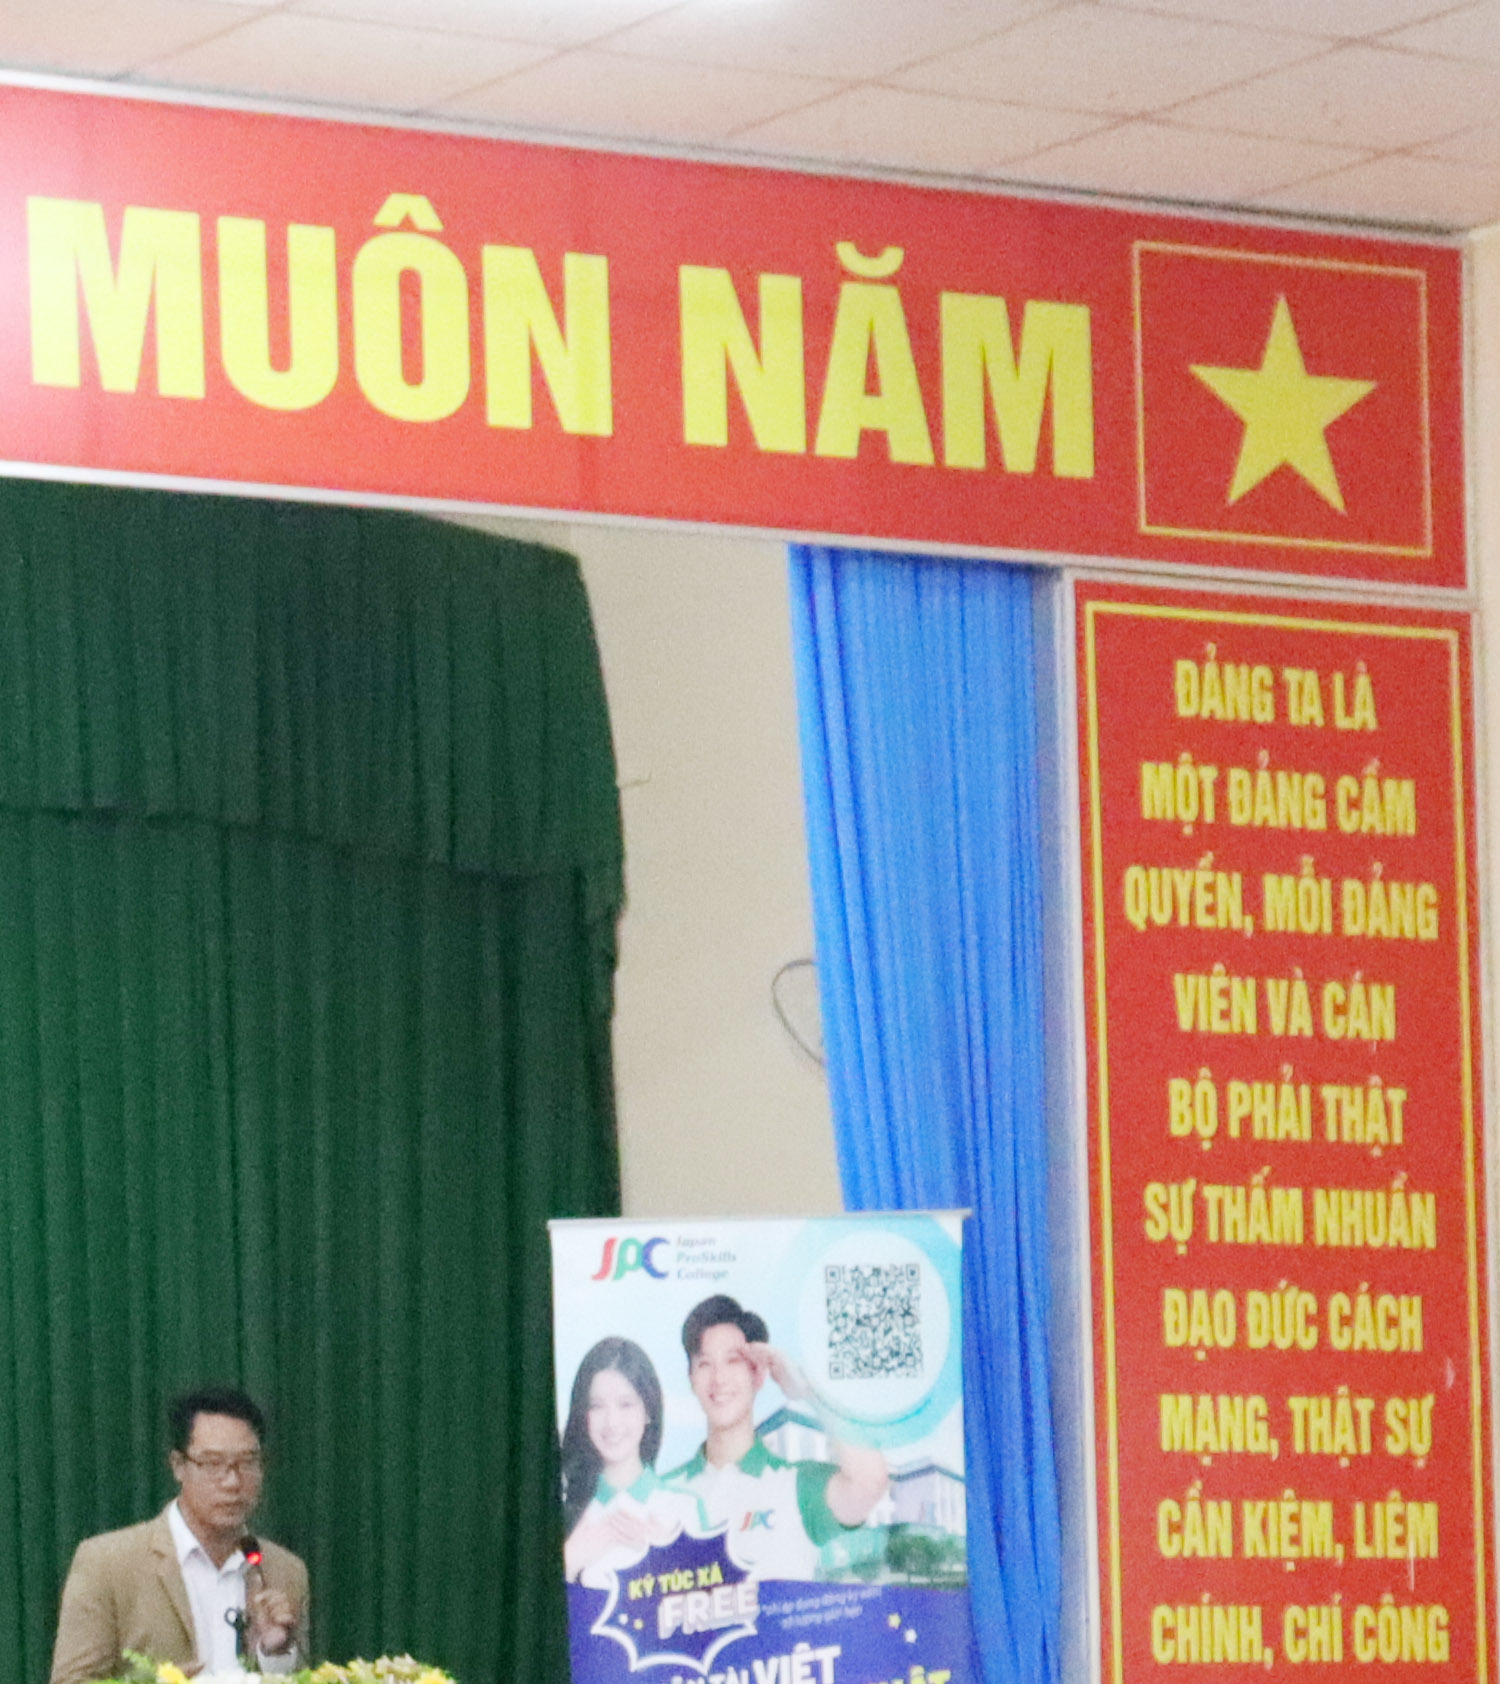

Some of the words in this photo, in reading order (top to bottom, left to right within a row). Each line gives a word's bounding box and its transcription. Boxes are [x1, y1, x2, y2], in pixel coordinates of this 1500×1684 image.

[31, 191, 614, 437] MUÔN
[678, 241, 1095, 478] NĂM
[1174, 642, 1275, 724] ĐẢNG
[1283, 667, 1324, 727] TA
[1333, 661, 1377, 731] LÀ
[1141, 752, 1218, 836] MỘT
[1228, 750, 1327, 831] ĐẢNG
[1263, 855, 1333, 935] MỖI
[1342, 861, 1439, 940] ĐẢNG
[1173, 962, 1257, 1034] VIÊN
[1265, 966, 1313, 1037] VÀ
[1323, 970, 1396, 1041] CÁN
[1168, 1066, 1218, 1151] BỘ
[1227, 1063, 1312, 1141] PHẢI
[1321, 1075, 1407, 1157] THẬT
[1144, 1178, 1197, 1255] SỰ
[1203, 1165, 1304, 1244] THẤM
[592, 1236, 671, 1281] JPC
[1163, 1287, 1237, 1361] ĐẠO
[1246, 1279, 1318, 1350] ĐỨC
[1329, 1281, 1423, 1351] CÁCH
[1160, 1393, 1279, 1467] MẠNG,
[1288, 1385, 1374, 1468] THẬT
[1385, 1393, 1435, 1468] SỰ
[1243, 1488, 1345, 1572] KIỆM,
[1354, 1490, 1439, 1559] LIÊM
[657, 1580, 761, 1640] FREE
[658, 1568, 695, 1594] TÚC
[1151, 1592, 1274, 1671] CHÍNH,
[1284, 1593, 1343, 1664] CHÍ
[1353, 1593, 1450, 1663] CÔNG
